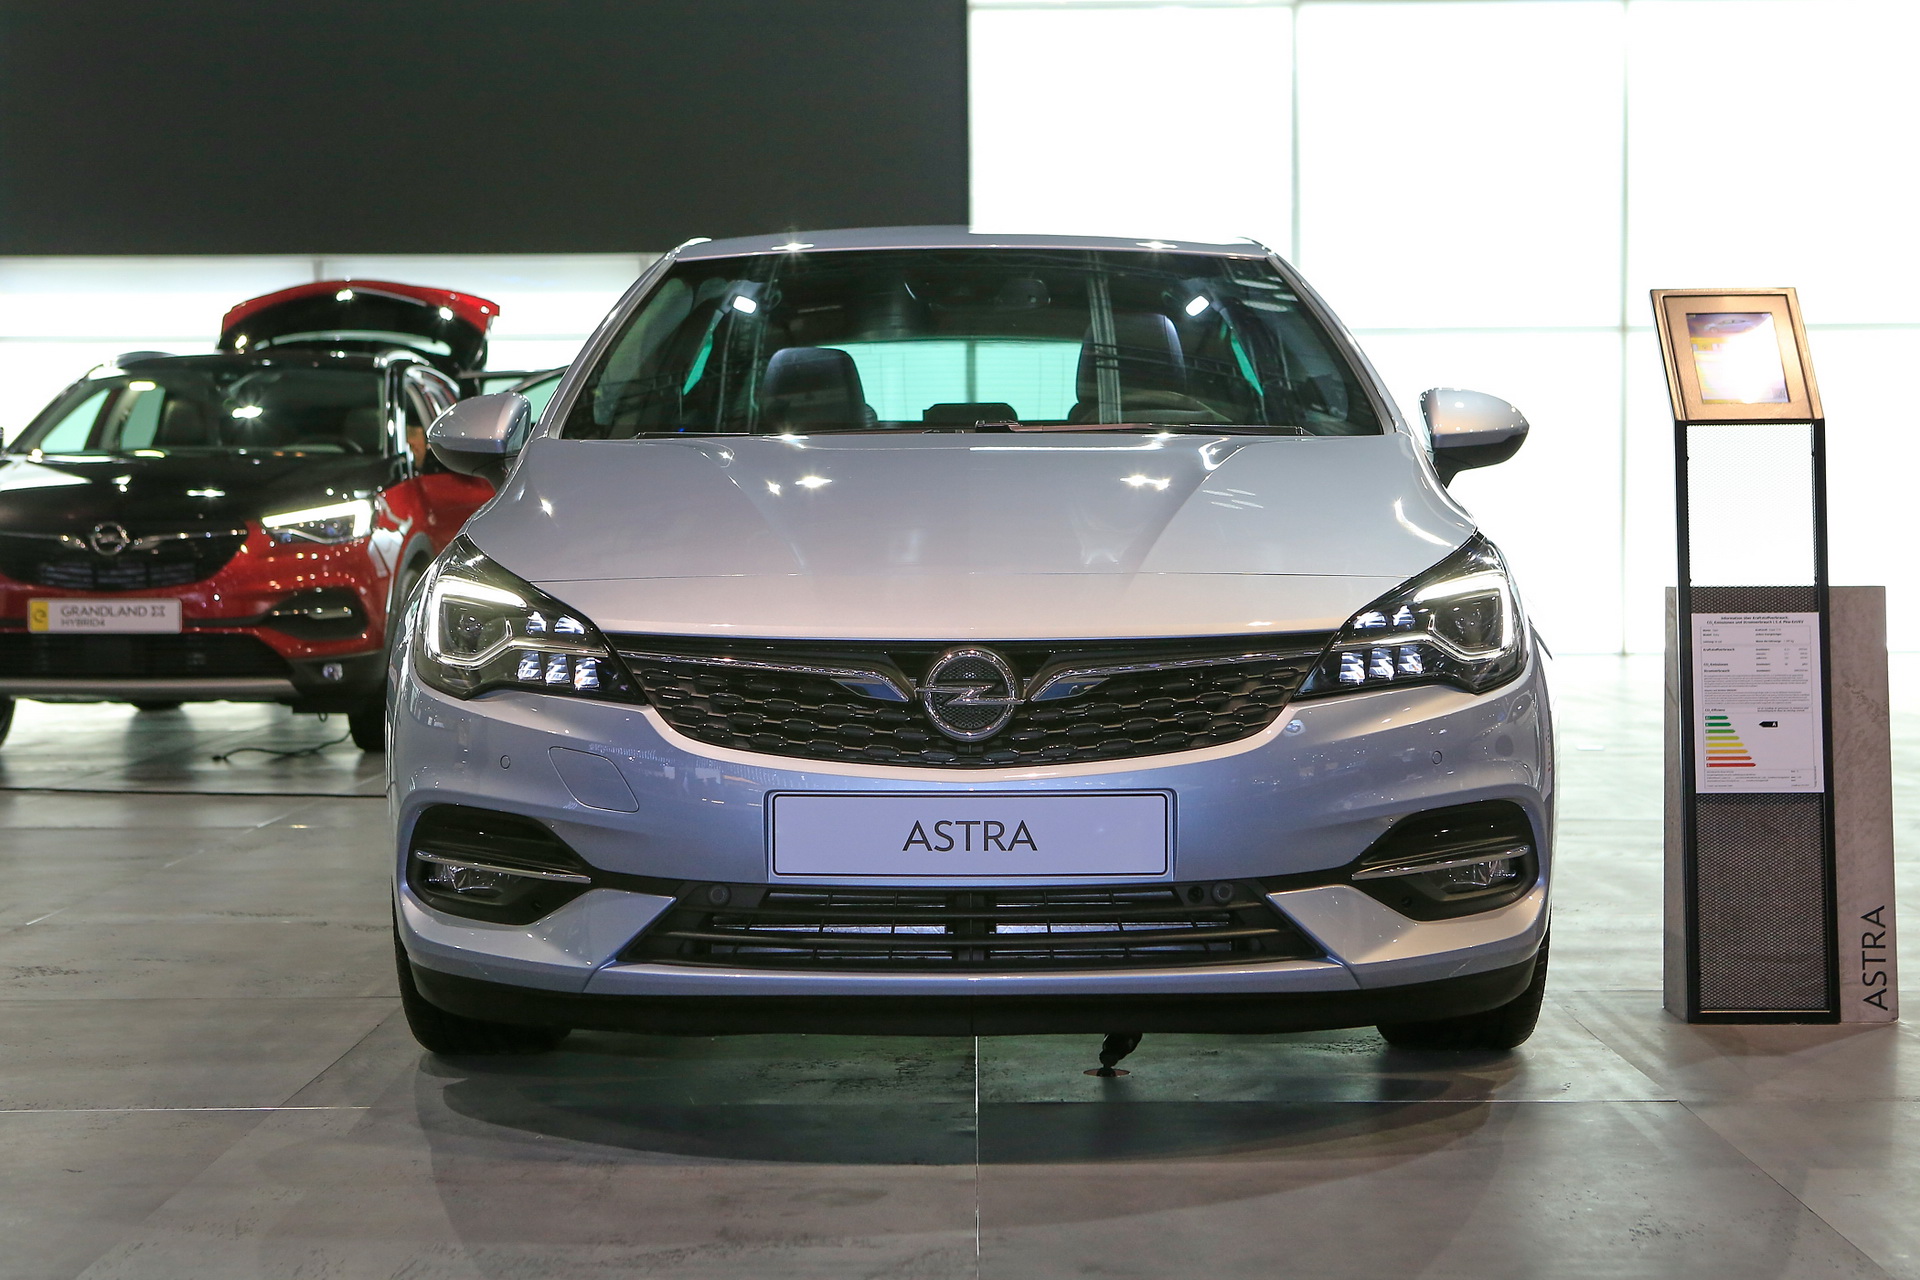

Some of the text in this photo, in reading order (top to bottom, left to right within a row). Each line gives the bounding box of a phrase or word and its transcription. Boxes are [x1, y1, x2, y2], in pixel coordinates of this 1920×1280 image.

[60, 605, 148, 617] GRANDLAND
[61, 618, 105, 627] HYBRID4
[902, 819, 1038, 852] ASTRA
[1860, 904, 1889, 1011] ASTRA
